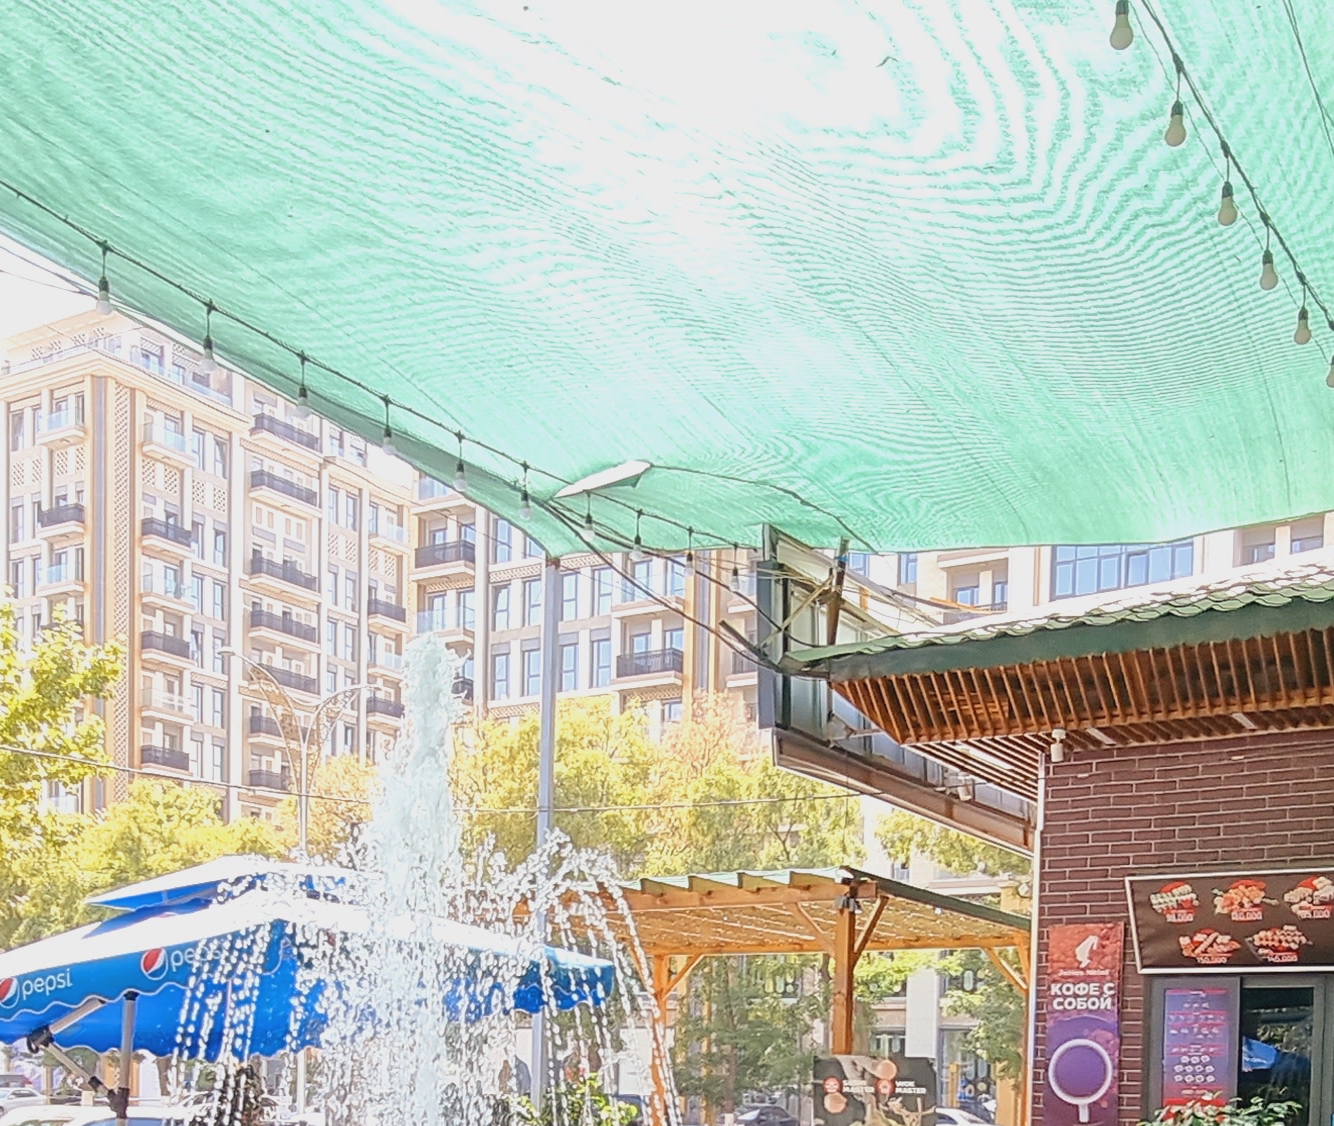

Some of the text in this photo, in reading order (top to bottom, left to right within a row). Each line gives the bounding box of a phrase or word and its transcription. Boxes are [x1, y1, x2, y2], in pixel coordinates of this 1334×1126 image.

[22, 968, 74, 997] pepsi
[1051, 982, 1100, 997] КОФЕ
[1053, 993, 1112, 1010] СОБОЙ
